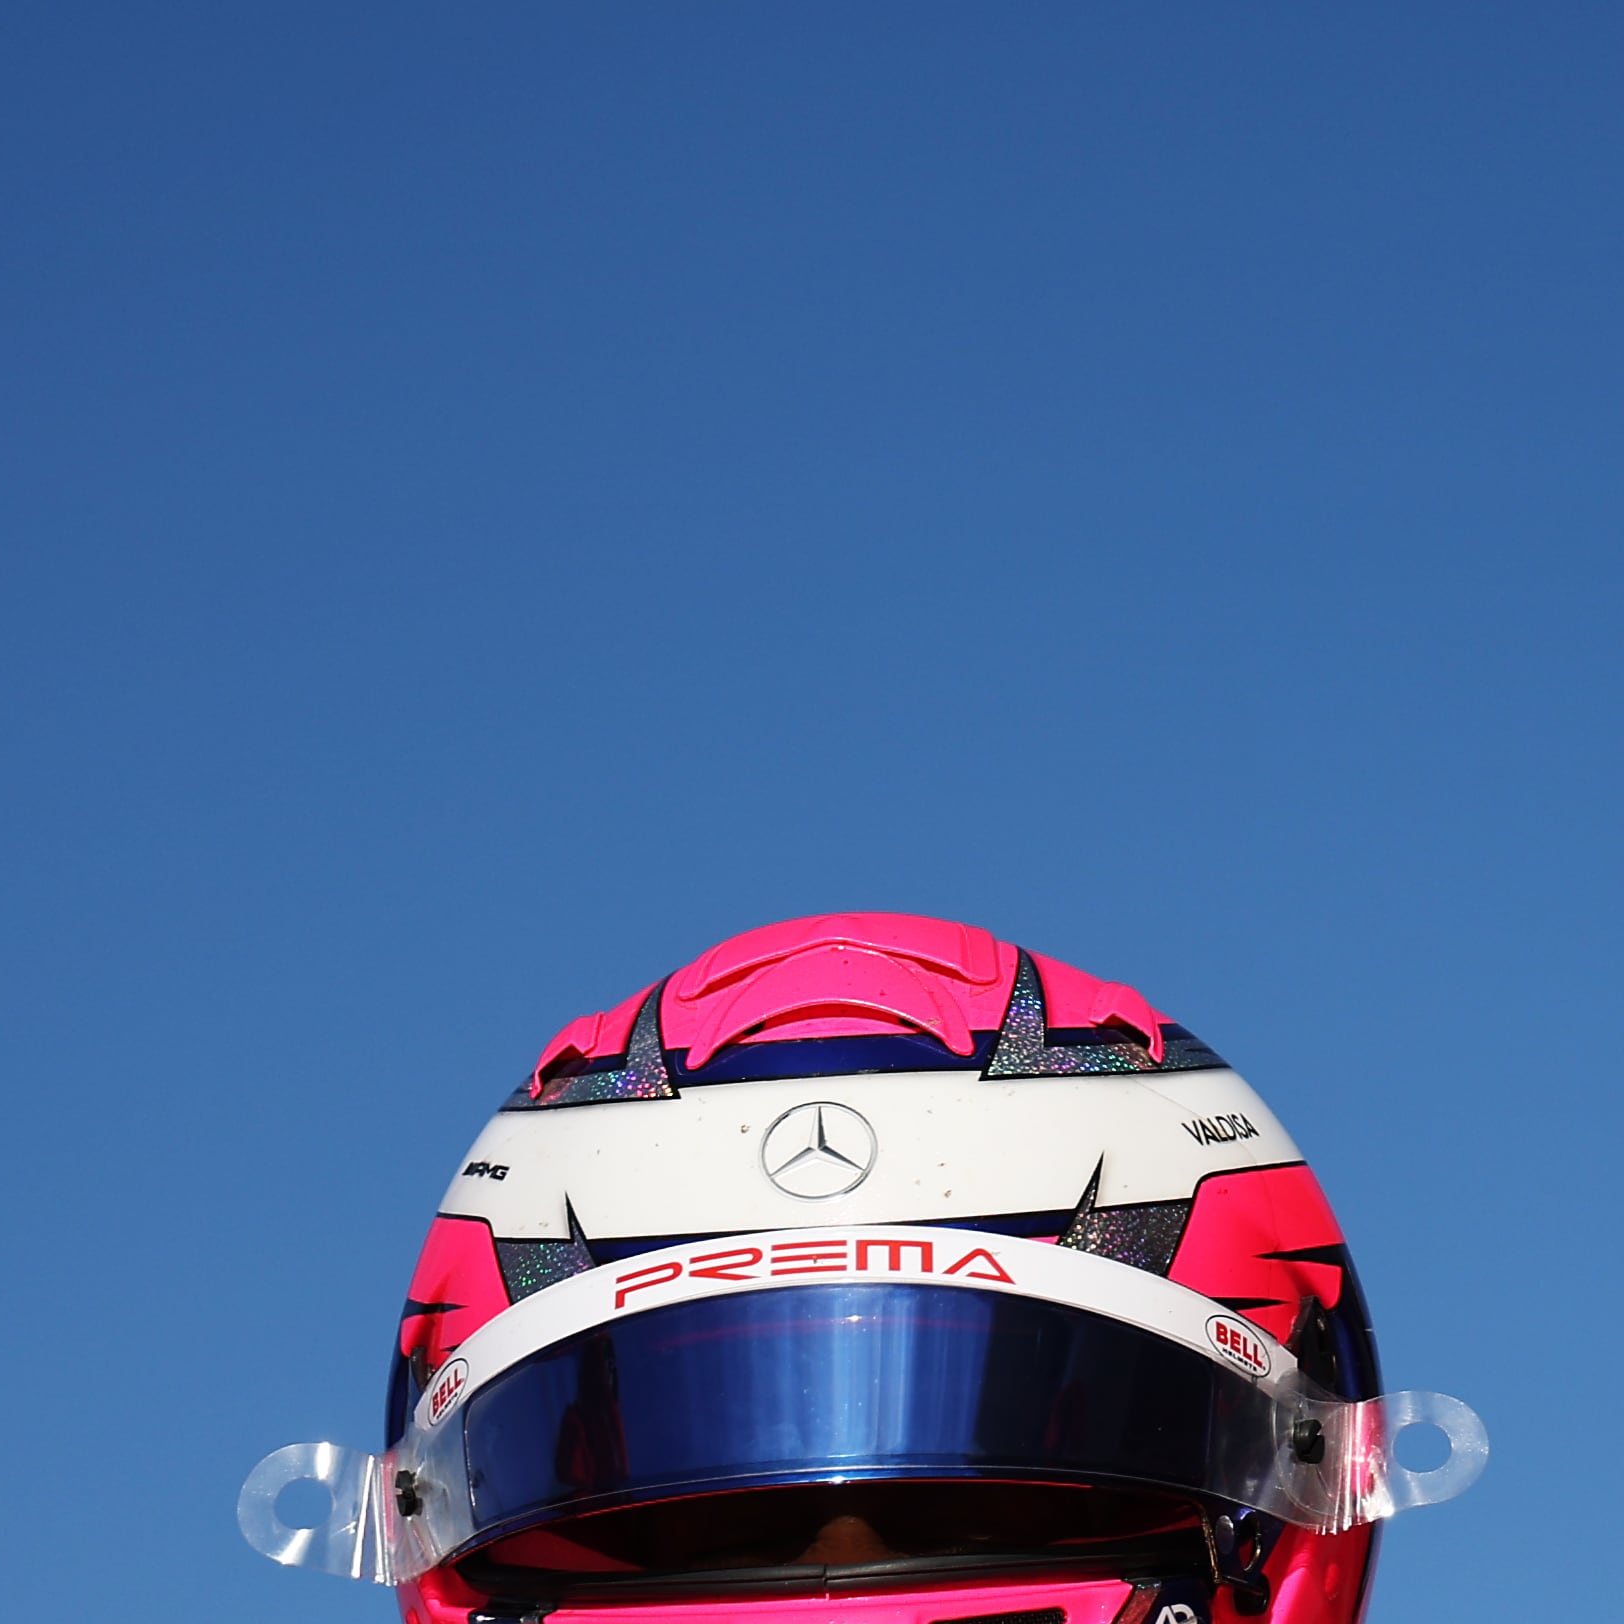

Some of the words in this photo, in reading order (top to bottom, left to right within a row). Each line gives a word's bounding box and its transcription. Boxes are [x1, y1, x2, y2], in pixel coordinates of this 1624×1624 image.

[1181, 1112, 1260, 1146] VALDISA
[614, 1239, 1016, 1310] PREMA
[1216, 1320, 1263, 1369] BELL
[432, 1367, 465, 1417] BELL
